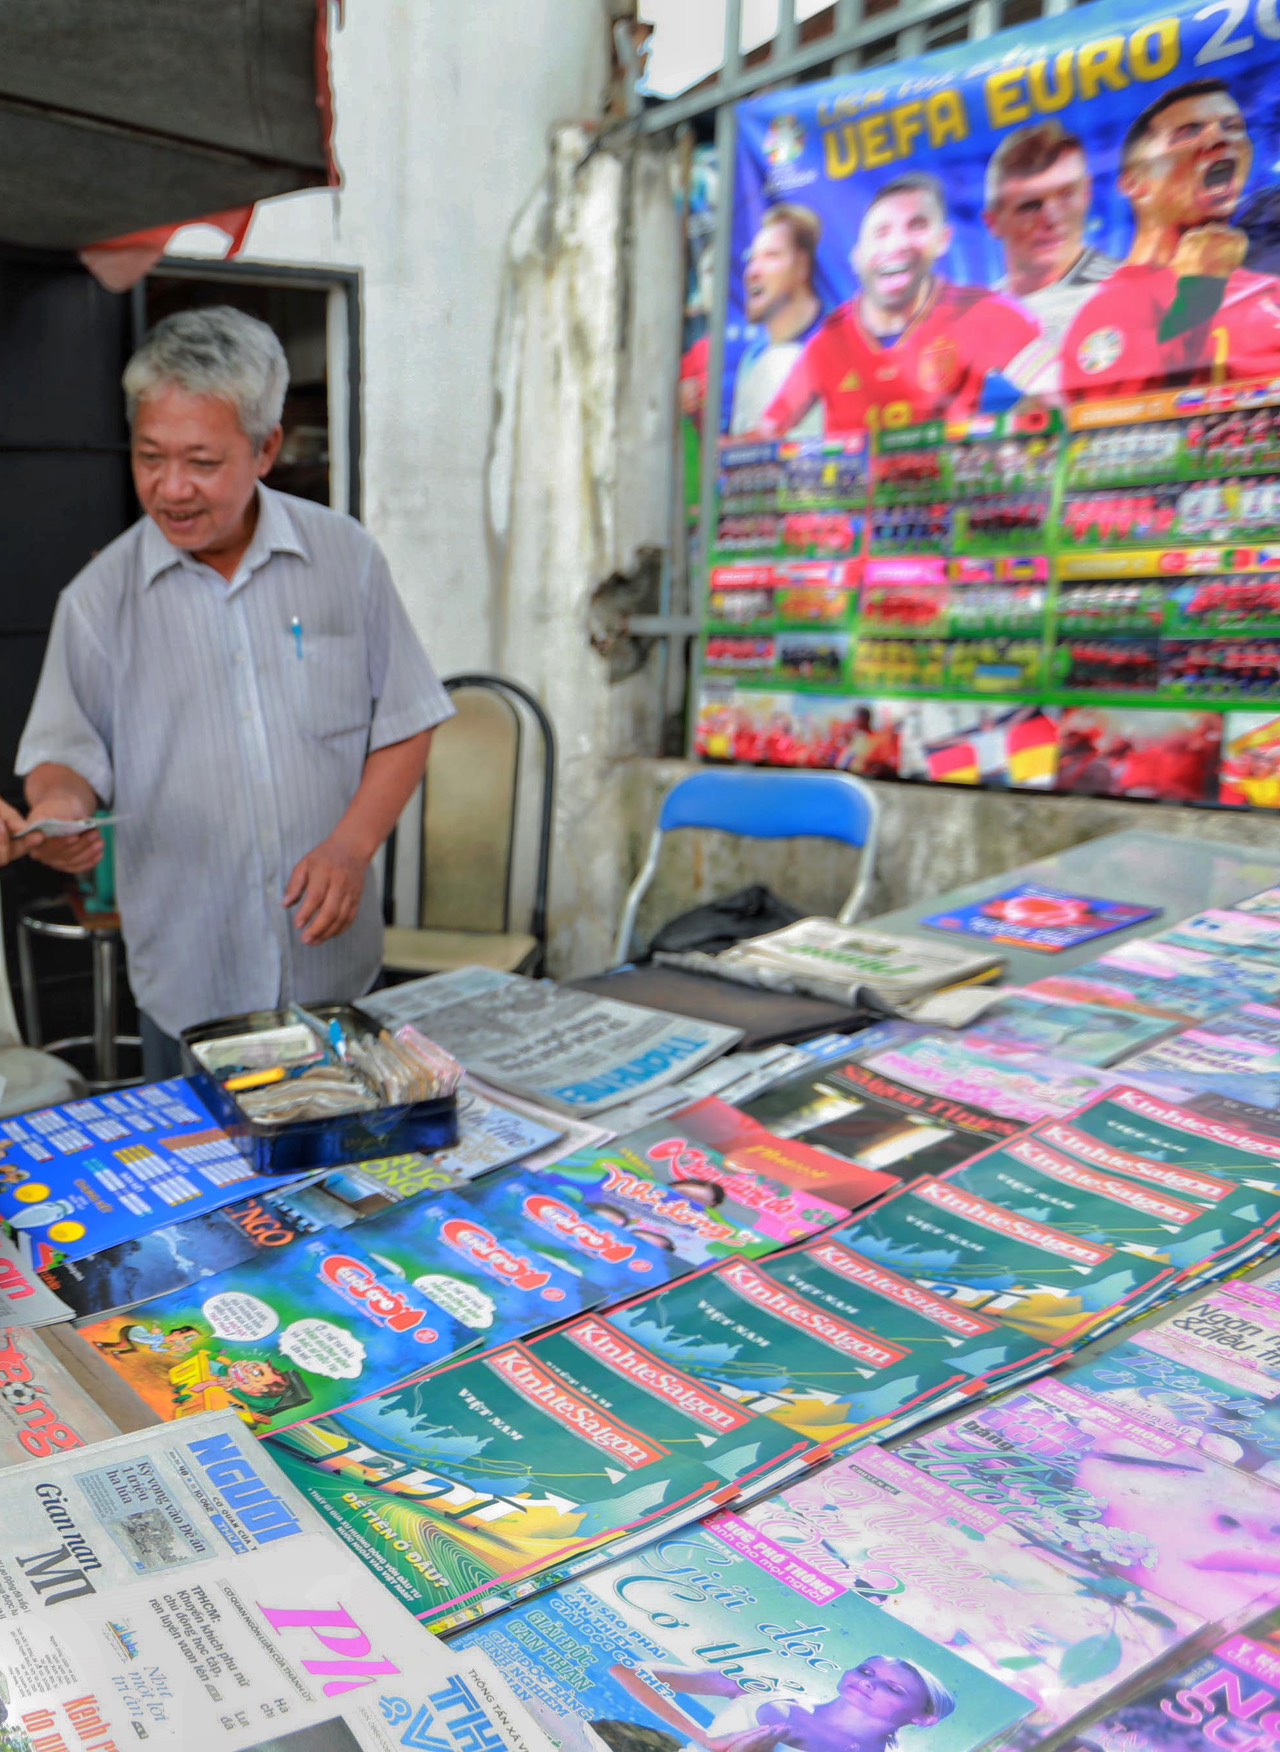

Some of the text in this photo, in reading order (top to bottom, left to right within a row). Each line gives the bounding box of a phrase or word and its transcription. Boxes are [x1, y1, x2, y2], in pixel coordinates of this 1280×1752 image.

[822, 88, 971, 181] UEFA
[985, 18, 1182, 131] EURO
[697, 1299, 771, 1348] VIỆT NAM
[1187, 1303, 1263, 1337] Ngăn
[457, 1387, 524, 1442] VIỆT NAM
[105, 1469, 137, 1504] ha lúa
[123, 1472, 153, 1501] triệu
[134, 1460, 208, 1553] Kỳ vọng vào Đề án
[31, 1479, 82, 1533] Gian
[61, 1528, 103, 1574] nan
[357, 1507, 401, 1541] TIỀN
[403, 1549, 451, 1591] ĐÂU?
[701, 1517, 736, 1542] dành
[733, 1539, 761, 1559] cho
[757, 1556, 786, 1578] mọi
[1, 1574, 17, 1591] Động
[15, 1596, 30, 1611] xếp
[188, 1584, 224, 1623] TPHCM:
[783, 1559, 836, 1599] THÔNG
[147, 1597, 166, 1614] rèn
[174, 1589, 207, 1623] Khuyến
[547, 1595, 584, 1627] GIẢI
[577, 1621, 615, 1654] ĐỘC
[475, 1636, 514, 1667] KINH
[504, 1617, 598, 1694] GAN THẬN
[524, 1605, 603, 1670] GIẢI ĐỘC
[592, 1612, 634, 1652] THIẾT
[597, 1603, 628, 1632] SAO
[626, 1625, 668, 1663] PHẢI
[467, 1668, 495, 1703] THÔNG
[492, 1703, 510, 1726] TẤN
[487, 1628, 599, 1722] GIẢI ĐỘC BẰNG
[22, 1709, 57, 1733] do
[62, 1694, 111, 1741] Kênh
